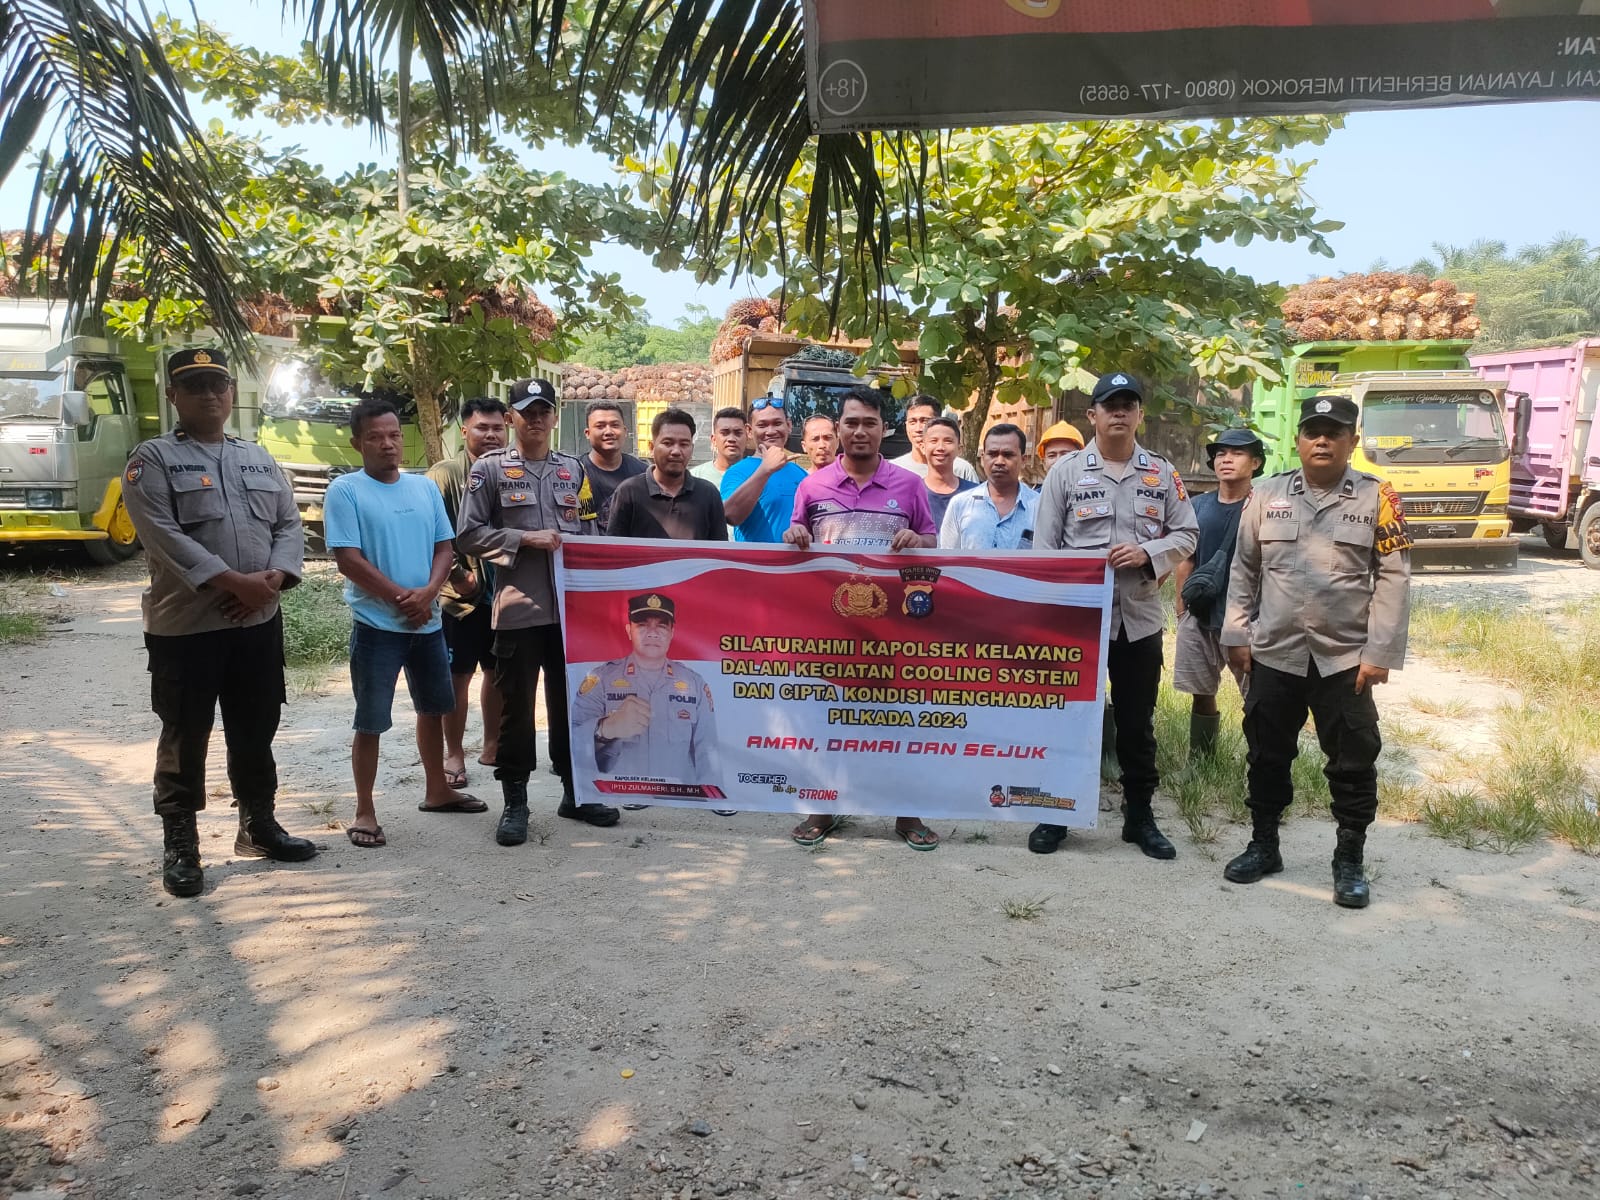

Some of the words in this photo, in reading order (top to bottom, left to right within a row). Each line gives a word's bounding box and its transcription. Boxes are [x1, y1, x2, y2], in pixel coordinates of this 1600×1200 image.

[240, 465, 273, 475] POLRI
[1075, 490, 1106, 502] HARY
[1136, 489, 1165, 501] POLRI
[1266, 510, 1293, 519] MADI
[1342, 513, 1373, 525] POLRI
[720, 635, 856, 656] SILATURAHMI
[861, 640, 969, 659] KAPOLSEK
[975, 643, 1083, 663] KELAYANG
[721, 658, 790, 676] DALAM
[794, 661, 895, 680] KEGIATAN
[901, 665, 991, 682] COOLING
[997, 667, 1079, 686] SYSTEM
[733, 682, 774, 699] DAN
[779, 683, 838, 701] CIPTA
[843, 686, 925, 704] KONDISI
[931, 689, 1065, 710] MENGHADAPI
[828, 708, 915, 727] PILKADA
[919, 711, 967, 729] 2024
[746, 735, 819, 752] AMAN,
[827, 738, 901, 753] DAMAI
[906, 741, 958, 756] DAN
[963, 743, 1049, 760] SEJUK
[738, 773, 787, 785] TOGETHER
[798, 788, 839, 801] STRONG
